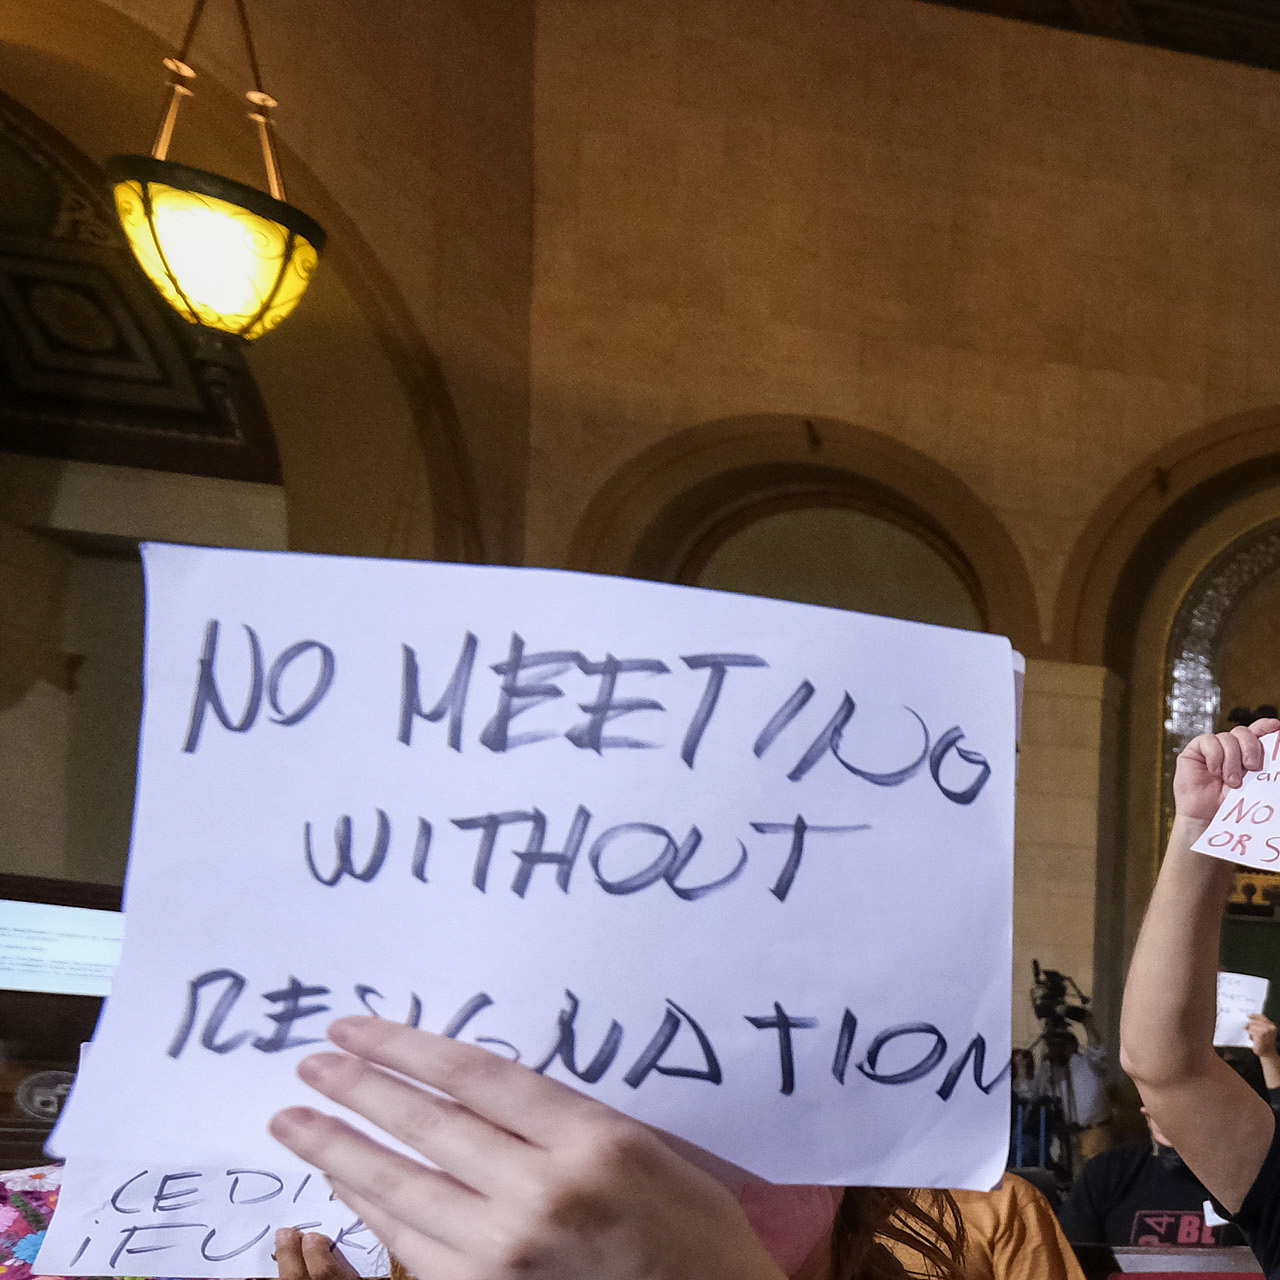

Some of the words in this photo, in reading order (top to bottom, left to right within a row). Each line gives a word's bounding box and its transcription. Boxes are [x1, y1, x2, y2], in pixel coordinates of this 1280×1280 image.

[183, 620, 335, 753] NO
[398, 631, 991, 805] MEETING
[1222, 798, 1274, 824] NO
[307, 803, 872, 902] WITHOUT
[1208, 831, 1252, 855] OR
[111, 1169, 337, 1214] CEDI
